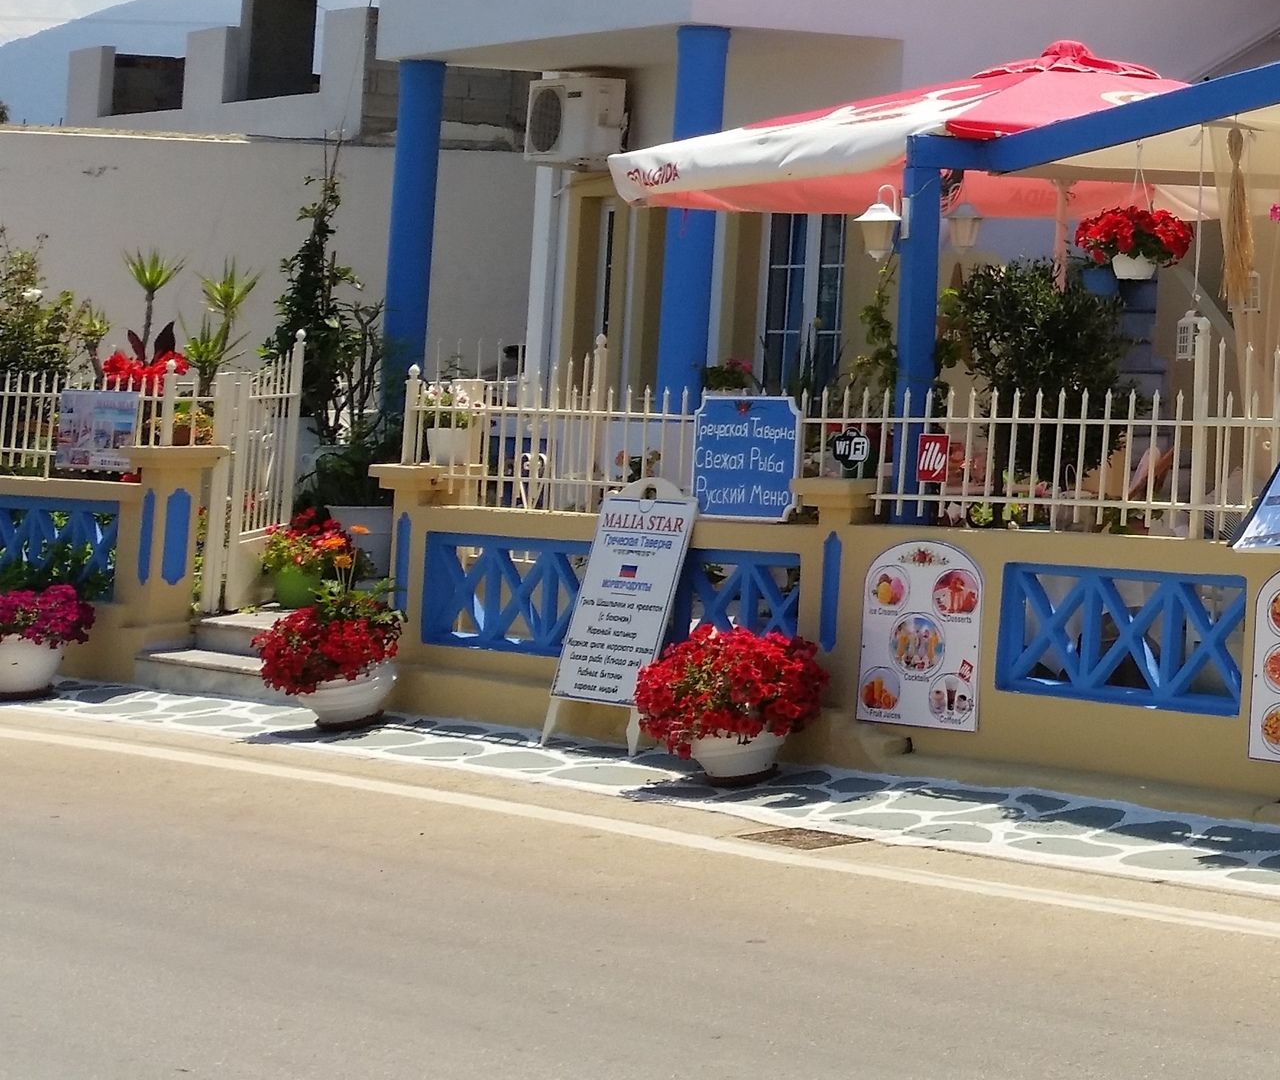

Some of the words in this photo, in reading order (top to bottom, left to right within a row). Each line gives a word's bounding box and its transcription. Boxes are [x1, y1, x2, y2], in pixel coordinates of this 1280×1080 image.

[697, 414, 748, 440] Греческая
[750, 417, 795, 444] Таверна
[695, 447, 745, 470] Свежая
[750, 447, 784, 472] Рыба
[919, 442, 946, 478] illy
[697, 476, 745, 511] Русский
[750, 485, 789, 506] Меню
[602, 512, 644, 529] MALIA
[646, 515, 685, 533] STAR
